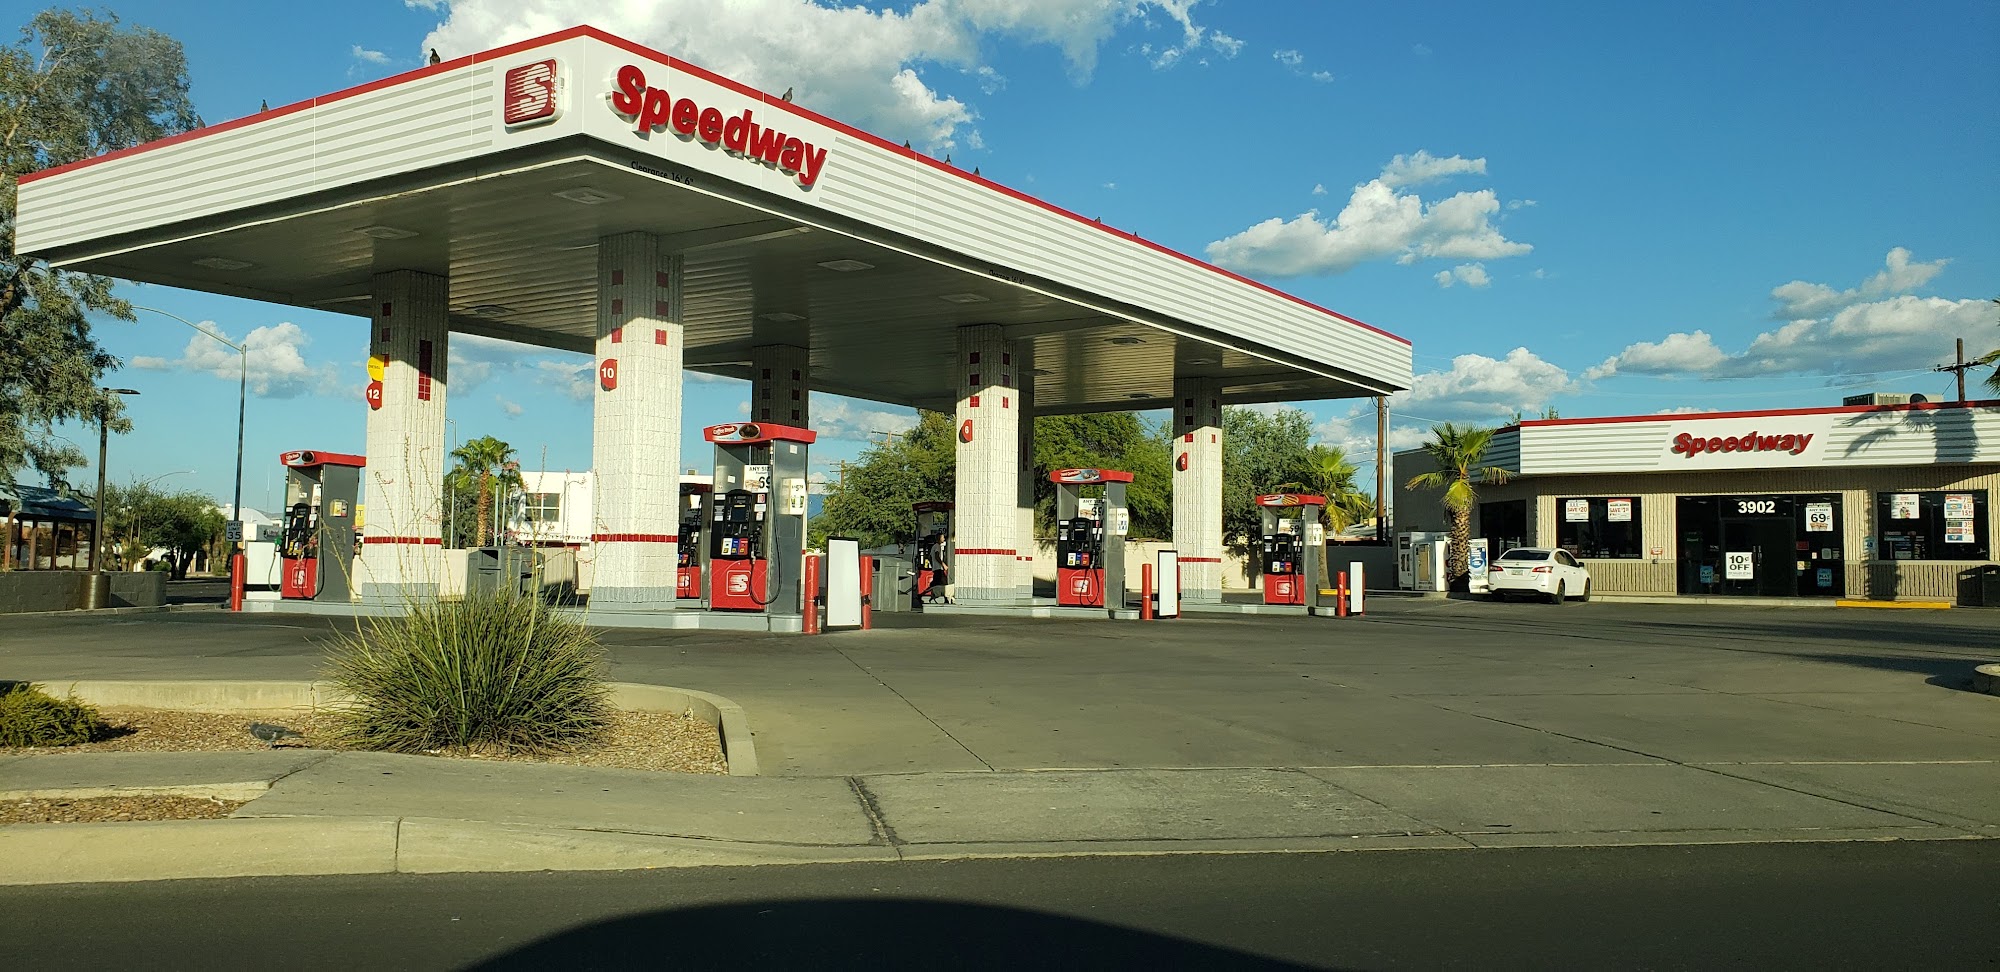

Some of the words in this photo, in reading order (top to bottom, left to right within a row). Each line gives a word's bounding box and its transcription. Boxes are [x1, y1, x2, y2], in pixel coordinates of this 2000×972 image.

[609, 65, 828, 188] Speedway
[631, 161, 668, 178] Clearance
[601, 367, 615, 379] 10
[367, 389, 380, 400] 12
[964, 425, 969, 434] 6
[1674, 431, 1814, 458] Speedway
[1738, 501, 1776, 514] 3902
[227, 531, 242, 540] 35
[1728, 555, 1750, 564] 10¢
